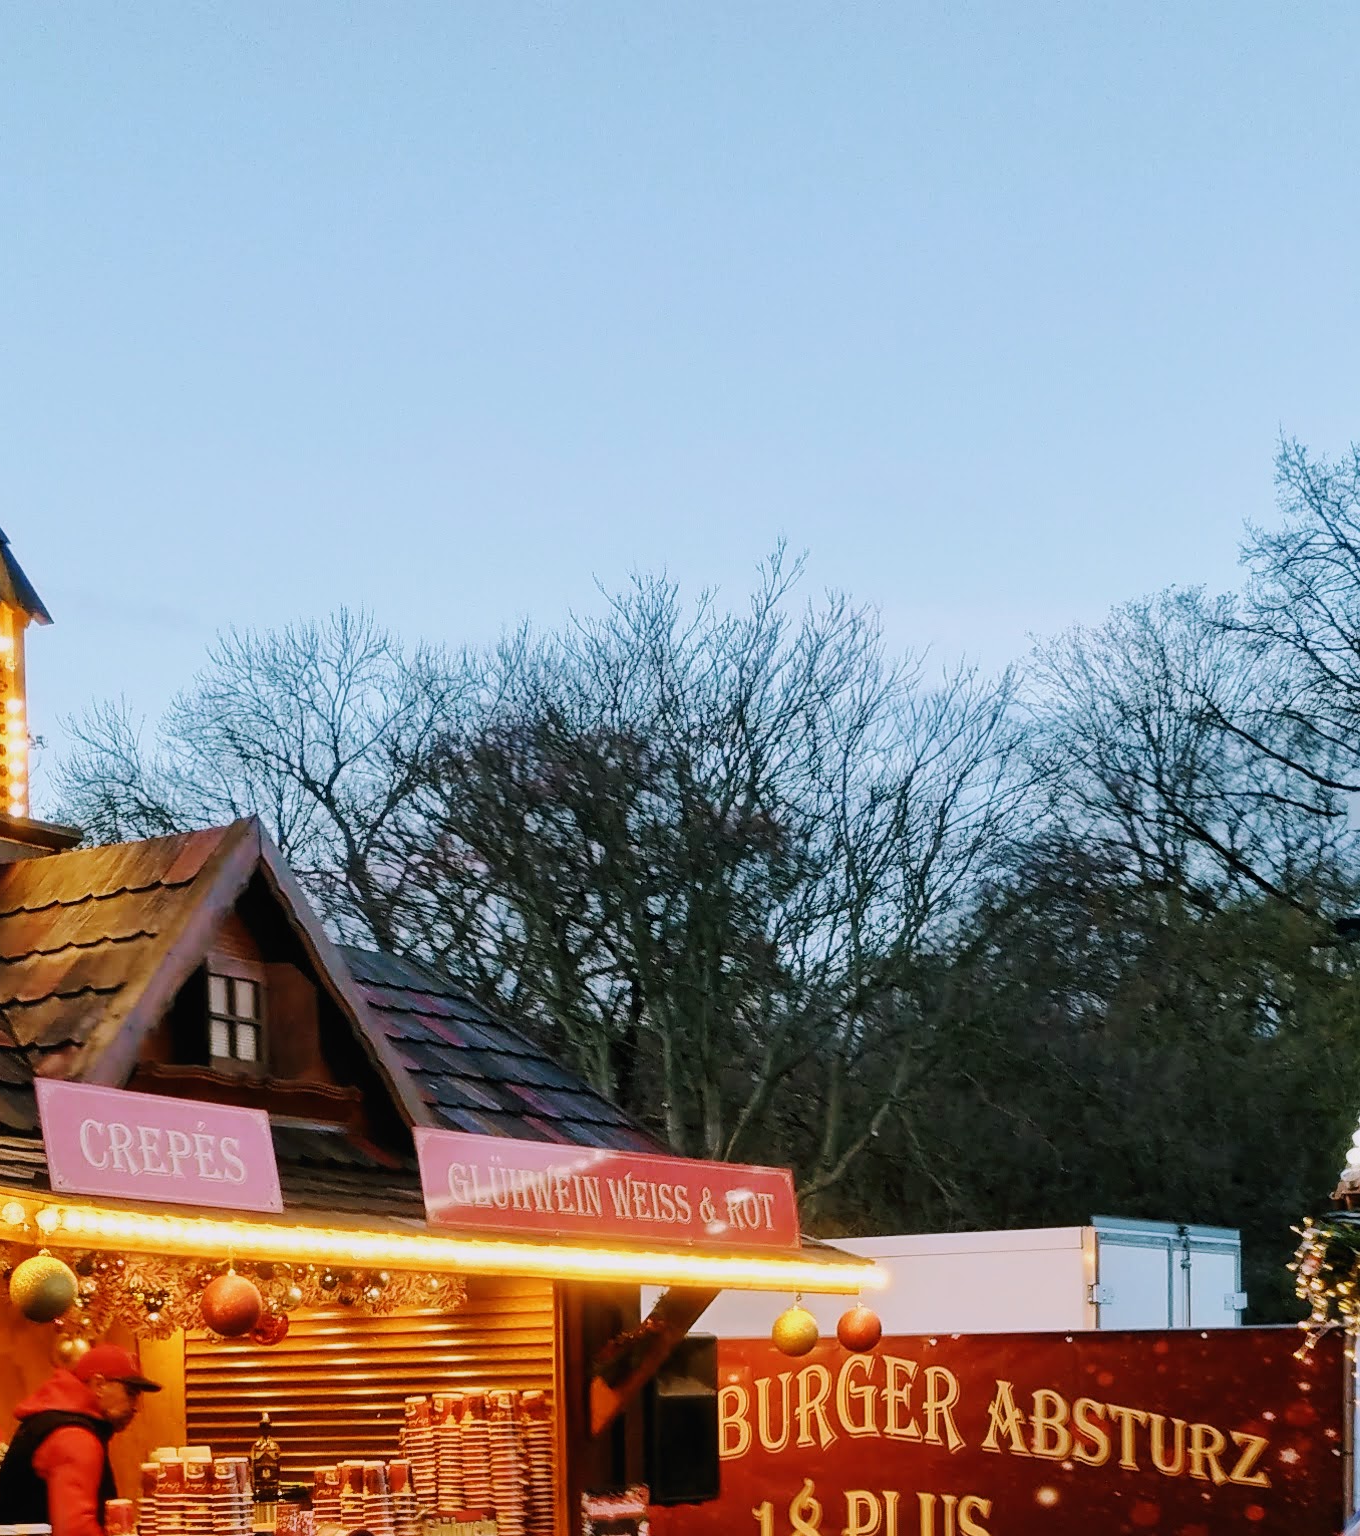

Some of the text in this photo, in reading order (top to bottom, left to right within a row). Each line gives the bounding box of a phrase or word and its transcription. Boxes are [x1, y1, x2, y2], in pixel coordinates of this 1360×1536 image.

[78, 1116, 247, 1186] CREPÉS
[447, 1155, 776, 1231] GLÜHWEIN WEISS & ROT
[718, 1354, 1272, 1488] BURGER ABSTURZ
